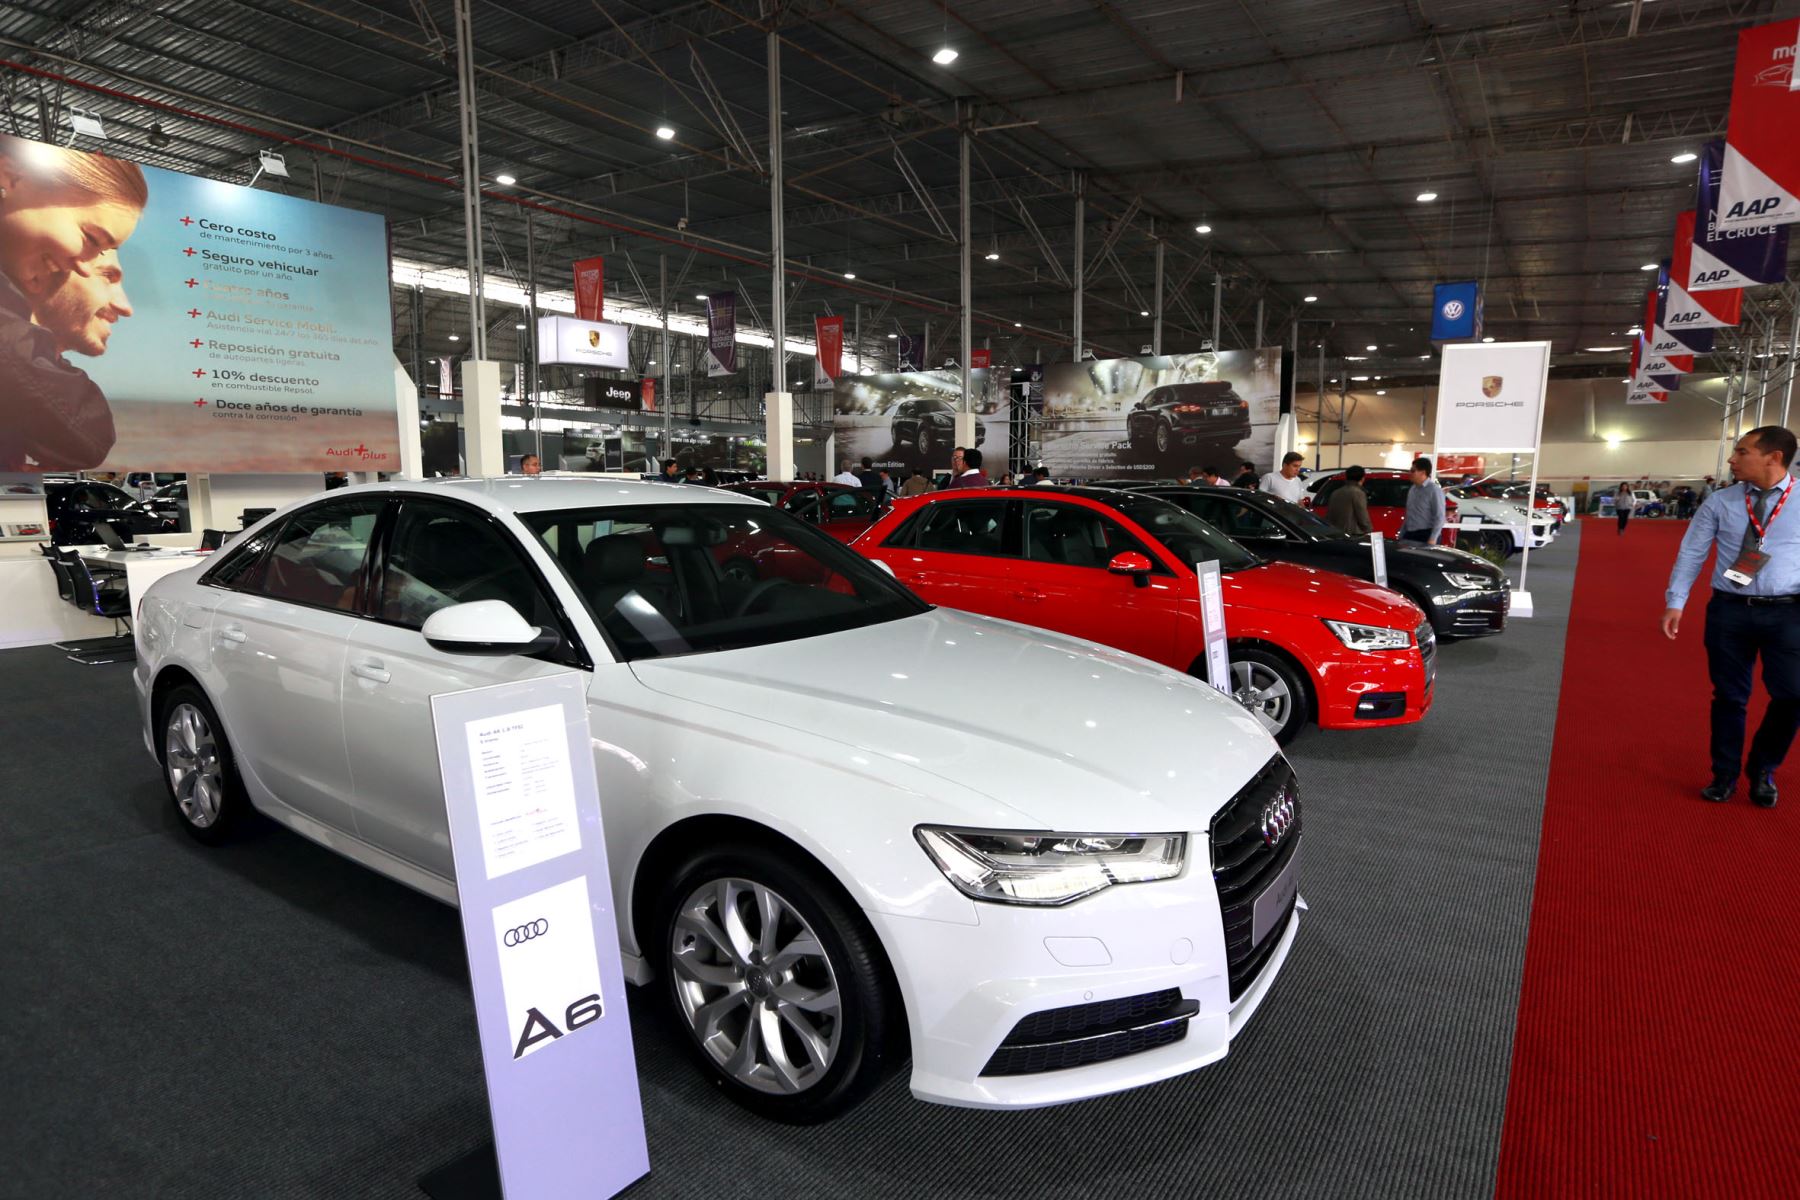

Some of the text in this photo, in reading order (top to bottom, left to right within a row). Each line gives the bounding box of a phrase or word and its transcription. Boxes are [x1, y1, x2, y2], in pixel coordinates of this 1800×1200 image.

[1726, 197, 1781, 218] AAP
[199, 218, 276, 241] Cero costo
[1707, 232, 1722, 242] EL
[1726, 225, 1777, 240] CRUCE
[200, 231, 212, 239] de
[214, 234, 286, 252] mantenimiento
[288, 247, 303, 255] por
[202, 249, 319, 276] Seguro vehicular
[203, 262, 242, 274] gratuito
[244, 268, 260, 277] por
[1695, 269, 1730, 283] AAP
[256, 288, 289, 300] años
[206, 310, 240, 322] Audi
[244, 313, 292, 329] Service
[1669, 312, 1701, 323] AAP
[206, 321, 256, 335] Asistencia
[208, 339, 340, 361] Reposición gratuita
[1655, 342, 1677, 350] AAP
[209, 351, 221, 359] de
[224, 353, 274, 364] autopartes
[1643, 363, 1666, 371] AAP
[212, 369, 319, 386] 10% descuento
[226, 382, 281, 392] combustible
[606, 387, 631, 401] Jeep
[216, 399, 363, 417] Doce años de garantía
[212, 411, 297, 421] contra la corrosión
[1112, 441, 1132, 450] Pack
[326, 447, 387, 461] Audi plus
[513, 993, 602, 1060] A6
